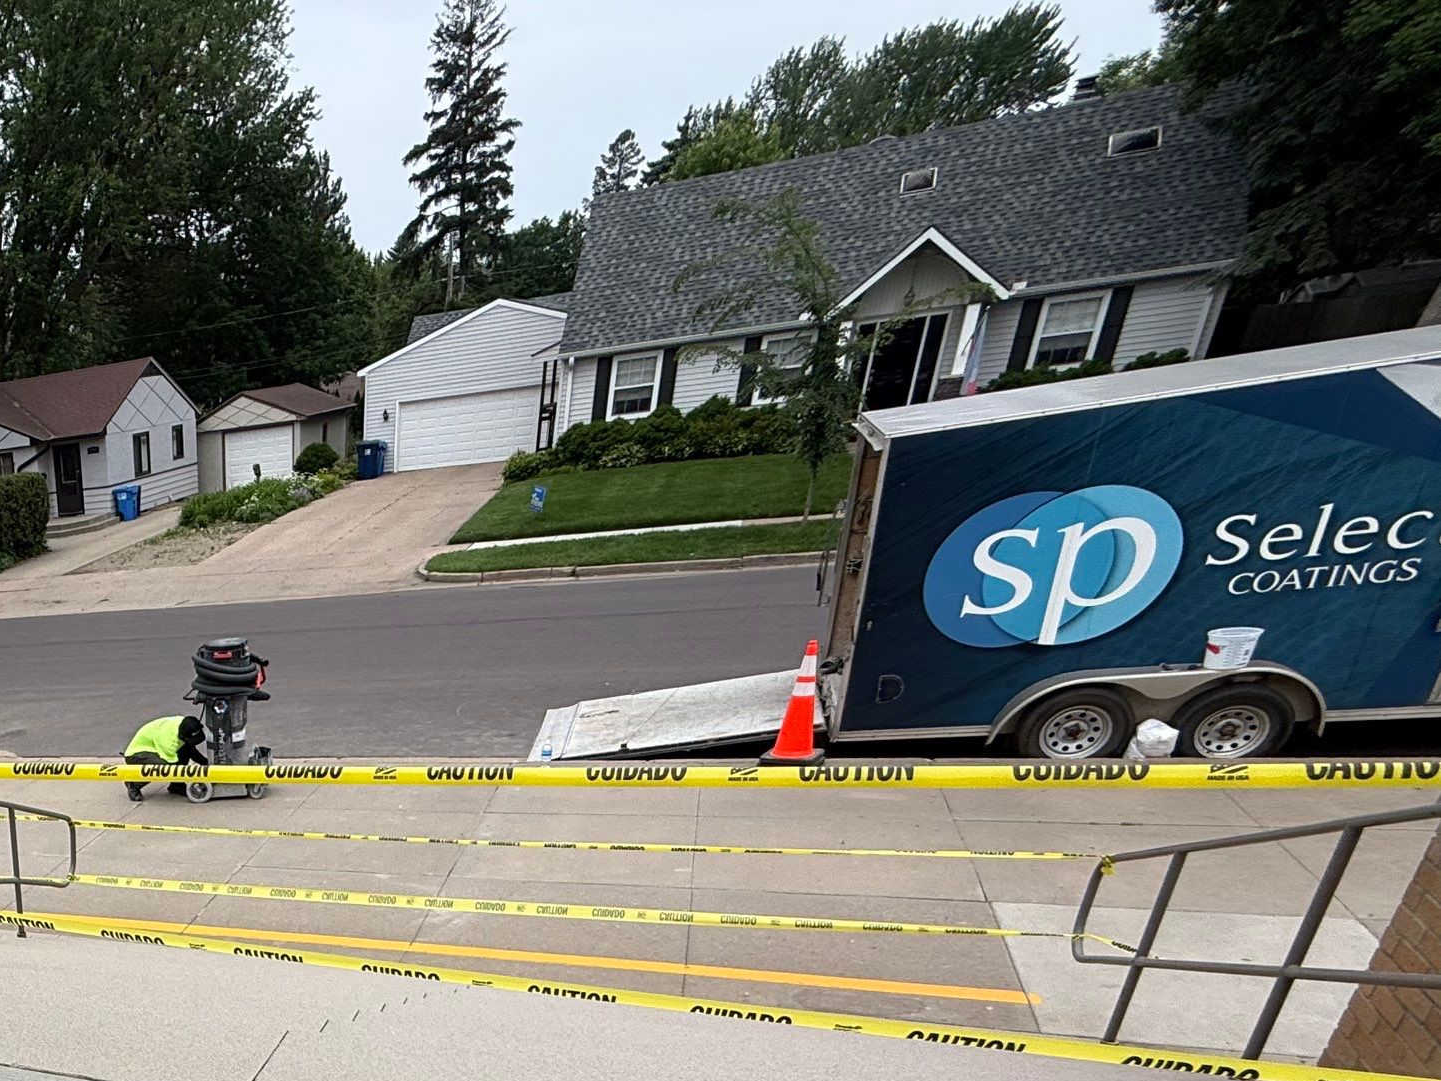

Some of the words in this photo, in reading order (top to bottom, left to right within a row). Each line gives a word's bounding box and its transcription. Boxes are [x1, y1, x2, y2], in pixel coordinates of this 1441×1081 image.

[1205, 503, 1441, 566] Selec
[960, 517, 1157, 645] sp
[1228, 557, 1422, 595] COATINGS
